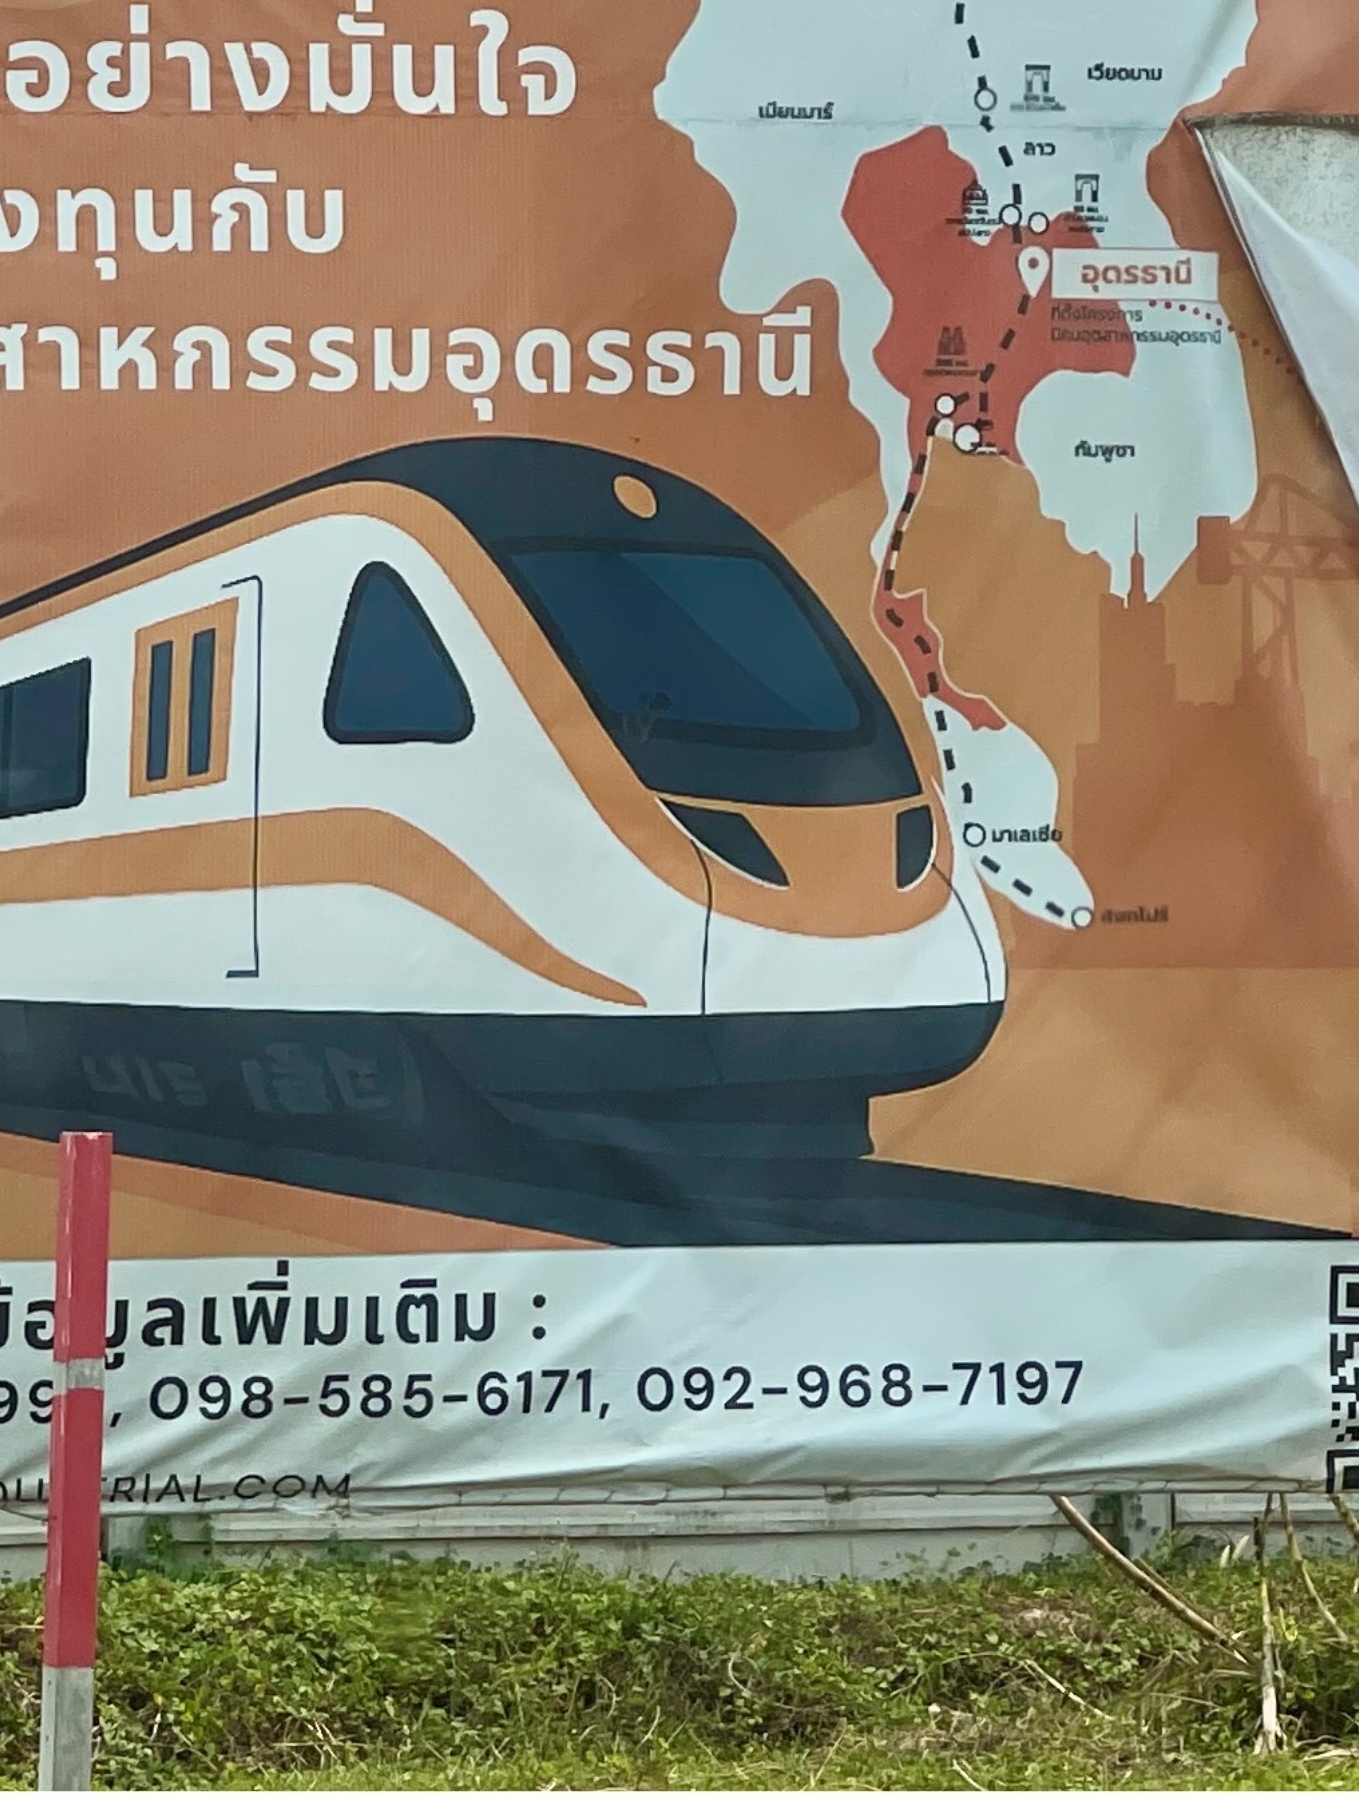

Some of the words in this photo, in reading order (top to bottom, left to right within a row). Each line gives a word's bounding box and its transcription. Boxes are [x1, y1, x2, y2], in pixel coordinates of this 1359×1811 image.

[1023, 141, 1056, 157] ลาว
[1081, 257, 1192, 293] อุดรธานี
[150, 1368, 611, 1421] 098-585-6171,
[636, 1360, 1084, 1413] 092-968-7197
